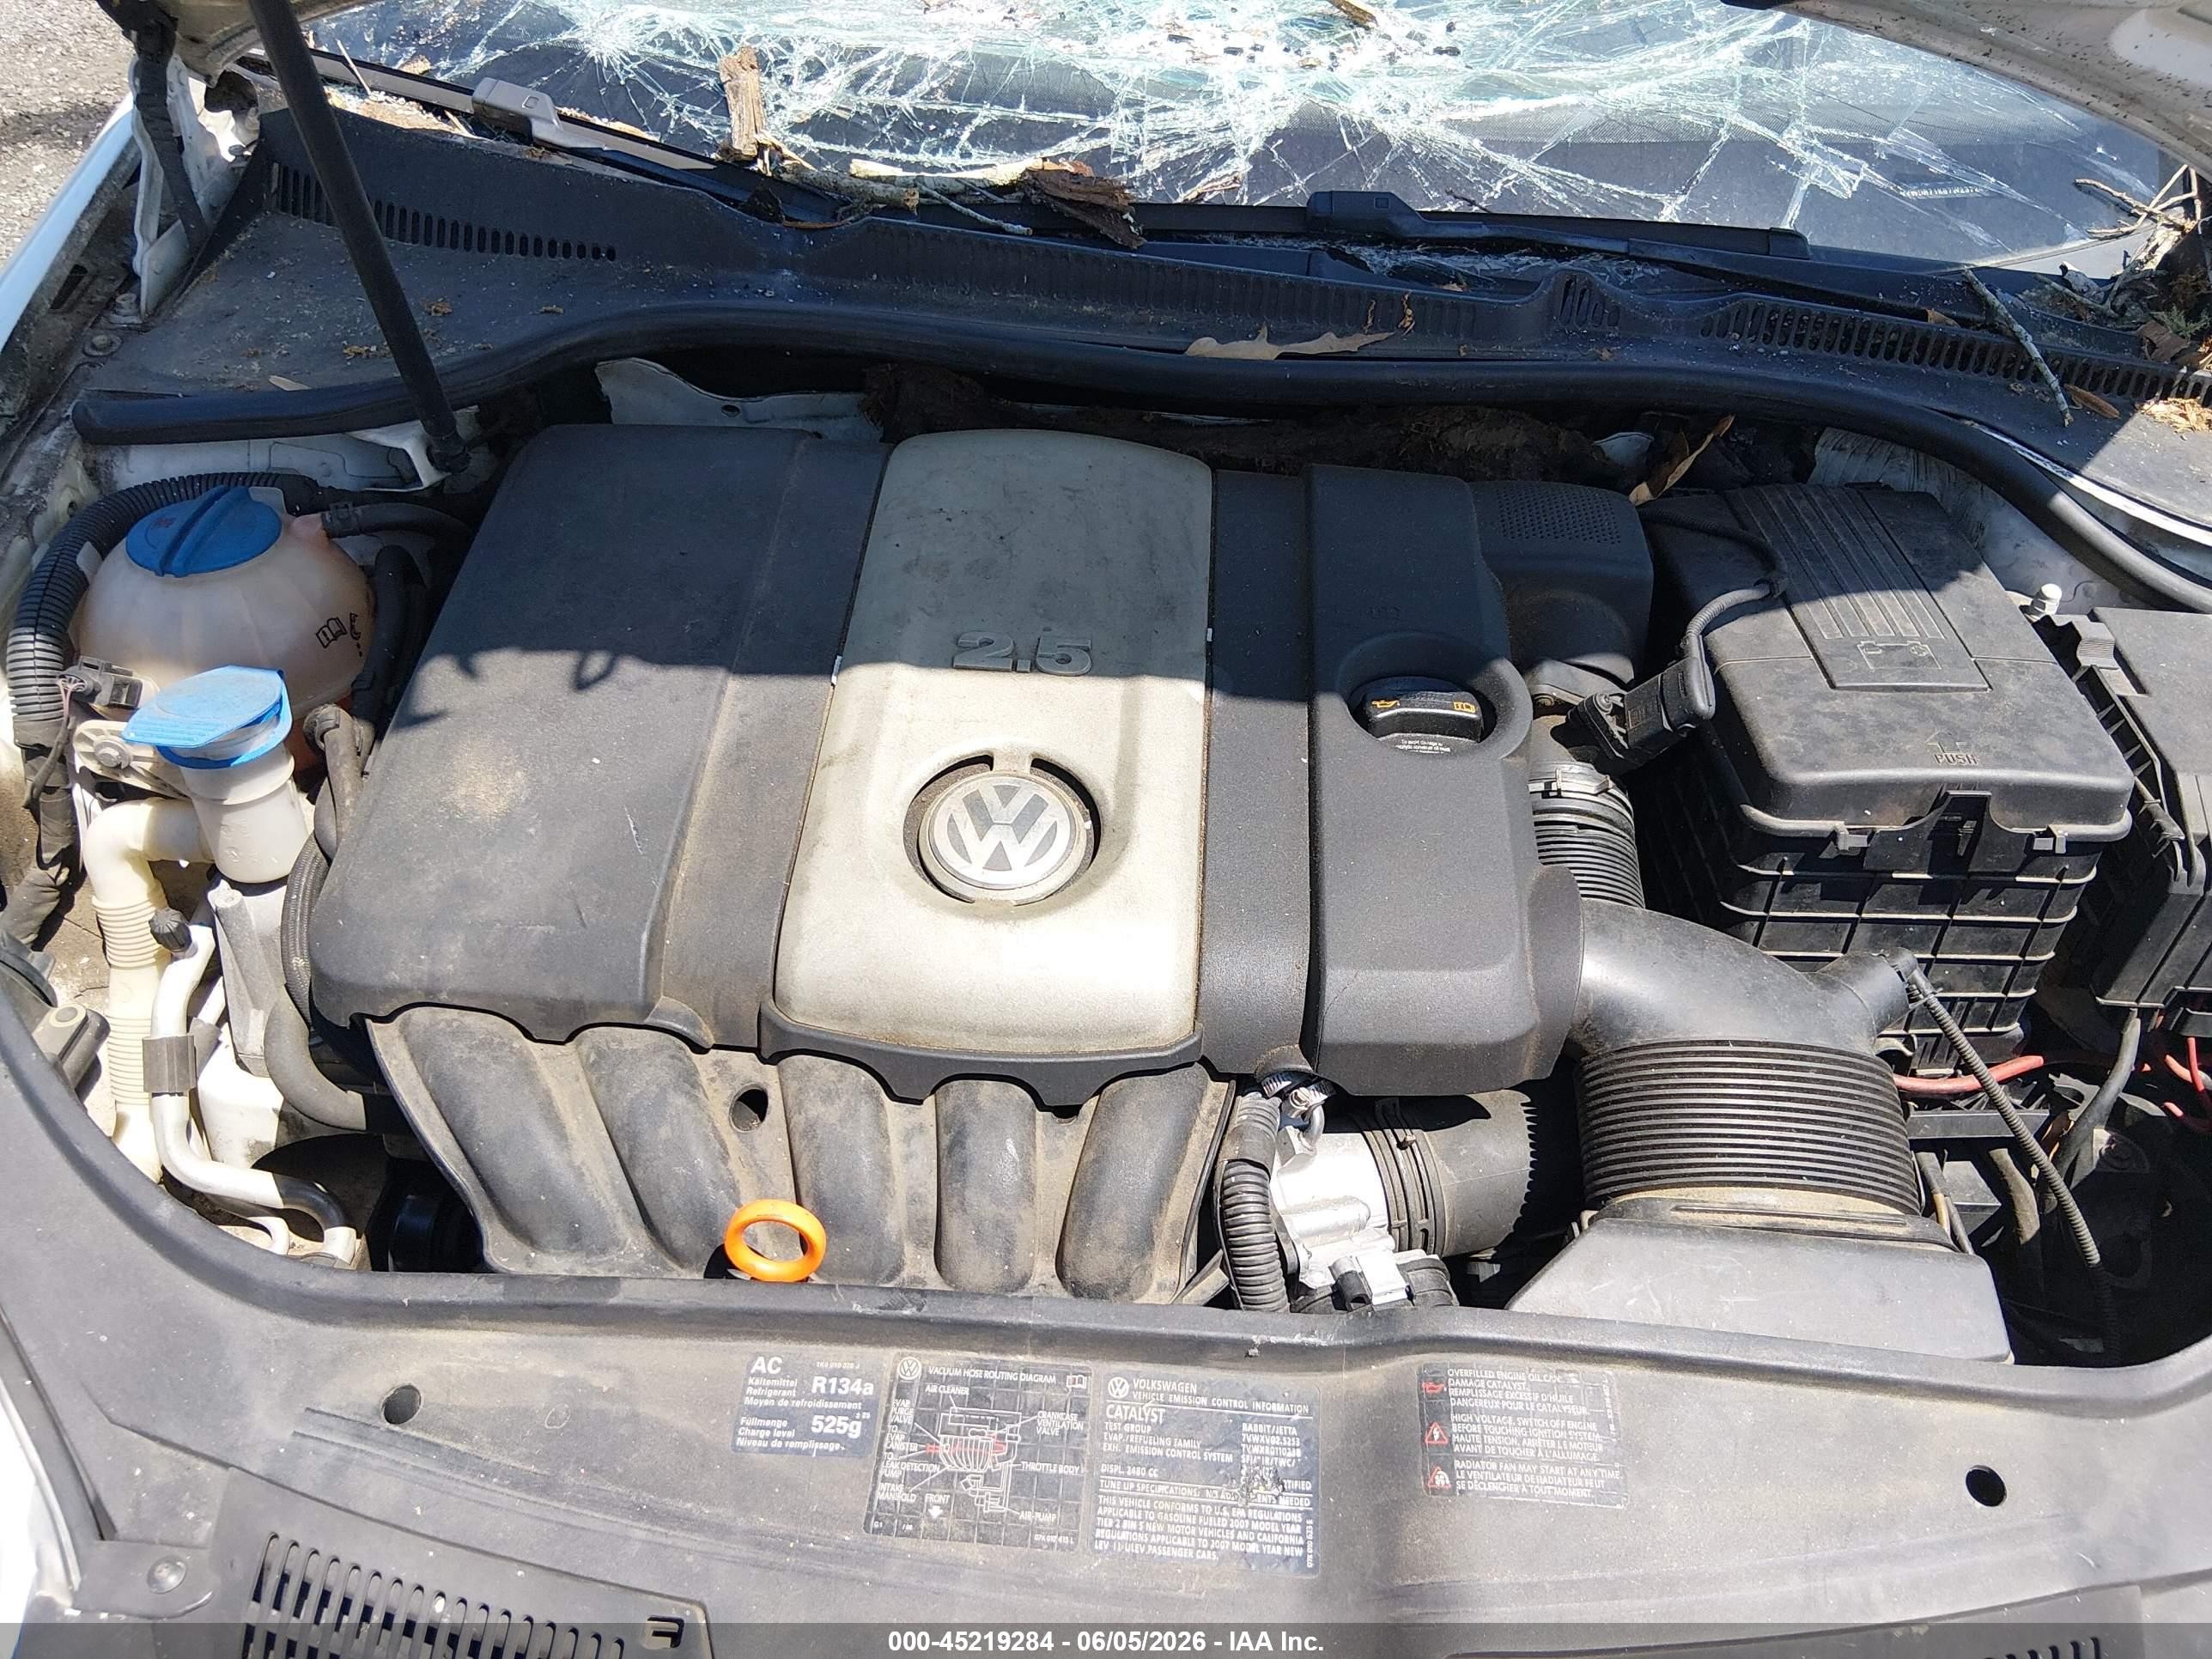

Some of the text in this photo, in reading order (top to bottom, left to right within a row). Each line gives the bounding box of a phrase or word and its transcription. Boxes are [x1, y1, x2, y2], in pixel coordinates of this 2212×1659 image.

[952, 630, 1092, 677] 2.5
[1934, 753, 1978, 765] PUSH
[929, 775, 1075, 890] VW
[750, 1356, 783, 1374] AC
[748, 1376, 798, 1387] Kältemittel
[929, 1366, 1056, 1383] VACUUM HOSE ROUTING DIAGRAM
[1448, 1368, 1496, 1379] OVERFILLED
[1496, 1370, 1526, 1381] ENGINE
[811, 1376, 874, 1395] R134a
[925, 1384, 969, 1395] AIR CLEANER
[1133, 1378, 1197, 1395] VOLKSWAGEN
[1448, 1378, 1486, 1389] DAMAGE
[745, 1387, 796, 1397] Refrigerant
[1449, 1388, 1504, 1399] REMPLISSAGE
[1504, 1391, 1539, 1401] EXCESSIF
[744, 1397, 862, 1410] Moyen de refroidissement
[892, 1399, 910, 1407] EVAP
[1133, 1391, 1309, 1413] VEHICLE EMISSION CONTROL INFORMATION
[1450, 1397, 1500, 1408] DANGEREUX
[1501, 1401, 1525, 1410] POUR
[1526, 1401, 1535, 1411] LE
[891, 1407, 915, 1416] PURGE
[1037, 1410, 1079, 1421] CRANKCASE
[1105, 1404, 1166, 1425] CATALYST
[740, 1417, 787, 1428] Füllmenge
[811, 1414, 862, 1439] 525g
[890, 1415, 914, 1424] VALVE
[1036, 1419, 1084, 1431] VENTILATION
[1450, 1413, 1474, 1423] HIGH
[1516, 1417, 1549, 1427] SWITCH
[1549, 1419, 1565, 1429] OFF
[1566, 1420, 1597, 1431] ENGINE
[738, 1427, 795, 1439] Charge level
[1036, 1426, 1060, 1437] VALVE
[1103, 1421, 1152, 1433] TEST GROUP
[1242, 1422, 1297, 1436] RABBIT/JETTA
[1452, 1423, 1481, 1433] BEFORE
[1483, 1425, 1528, 1437] TOUCHING
[1529, 1428, 1567, 1439] IGNITION
[736, 1437, 841, 1452] Niveau de remplissage
[884, 1442, 919, 1451] CANISTER
[1103, 1431, 1202, 1449] EVAP./REFUELING FAMILY
[1452, 1433, 1481, 1443] HAUTE
[1557, 1440, 1568, 1449] LE
[1569, 1441, 1603, 1452] MOTEUR
[1103, 1442, 1233, 1463] EXH. EMISSION CONTROL SYSTEM
[1454, 1443, 1483, 1453] AVANT
[1484, 1445, 1496, 1455] DE
[1497, 1446, 1535, 1457] TOUCHER
[879, 1468, 902, 1477] PUMP
[882, 1461, 940, 1472] LEAK DETECTION
[1021, 1461, 1080, 1474] THROTTLE BODY
[1100, 1463, 1158, 1477] DISPL. 2480 CC
[1455, 1459, 1498, 1470] RADIATOR
[1499, 1462, 1516, 1471] FAN
[1518, 1463, 1537, 1473] MAY
[1539, 1465, 1565, 1475] START
[1567, 1467, 1577, 1476] AT
[1580, 1468, 1598, 1477] ANY
[1455, 1469, 1466, 1479] LE
[1466, 1470, 1522, 1482] VENTILATEUR
[1524, 1474, 1535, 1484] DE
[878, 1482, 905, 1492] INTAKE
[1099, 1479, 1121, 1488] TUNE
[1123, 1480, 1134, 1489] UP
[1136, 1483, 1200, 1497] SPECIFICATIONS:
[1456, 1480, 1466, 1490] SE
[1528, 1484, 1552, 1494] TOUT
[877, 1492, 916, 1502] MANIFOLD
[926, 1494, 951, 1504] FRONT
[1279, 1497, 1310, 1507] NEEDED
[1098, 1495, 1116, 1505] THIS
[1119, 1497, 1151, 1509] VEHICLE
[1153, 1500, 1199, 1514] CONFORMS
[1201, 1504, 1212, 1515] TO
[1232, 1508, 1246, 1517] EPA
[1248, 1509, 1303, 1522] REGULATIONS
[1097, 1506, 1301, 1534] APPLICABLE TO GASOLINE FUELED 2007 MODEL YEAR
[1096, 1517, 1113, 1528] TIER
[1115, 1519, 1121, 1528] 2
[1122, 1520, 1136, 1529] BIN
[1146, 1522, 1165, 1532] NEW
[1168, 1524, 1196, 1536] MOTOR
[1199, 1526, 1235, 1540] VEHICLES
[1237, 1530, 1255, 1540] AND
[1256, 1532, 1304, 1545] CALIFORNIA
[1095, 1528, 1304, 1557] REGULATIONS APPLICABLE TO 2007 MODEL YEAR NEW
[1094, 1540, 1218, 1560] LEV ULEV PASSENGER CARS.
